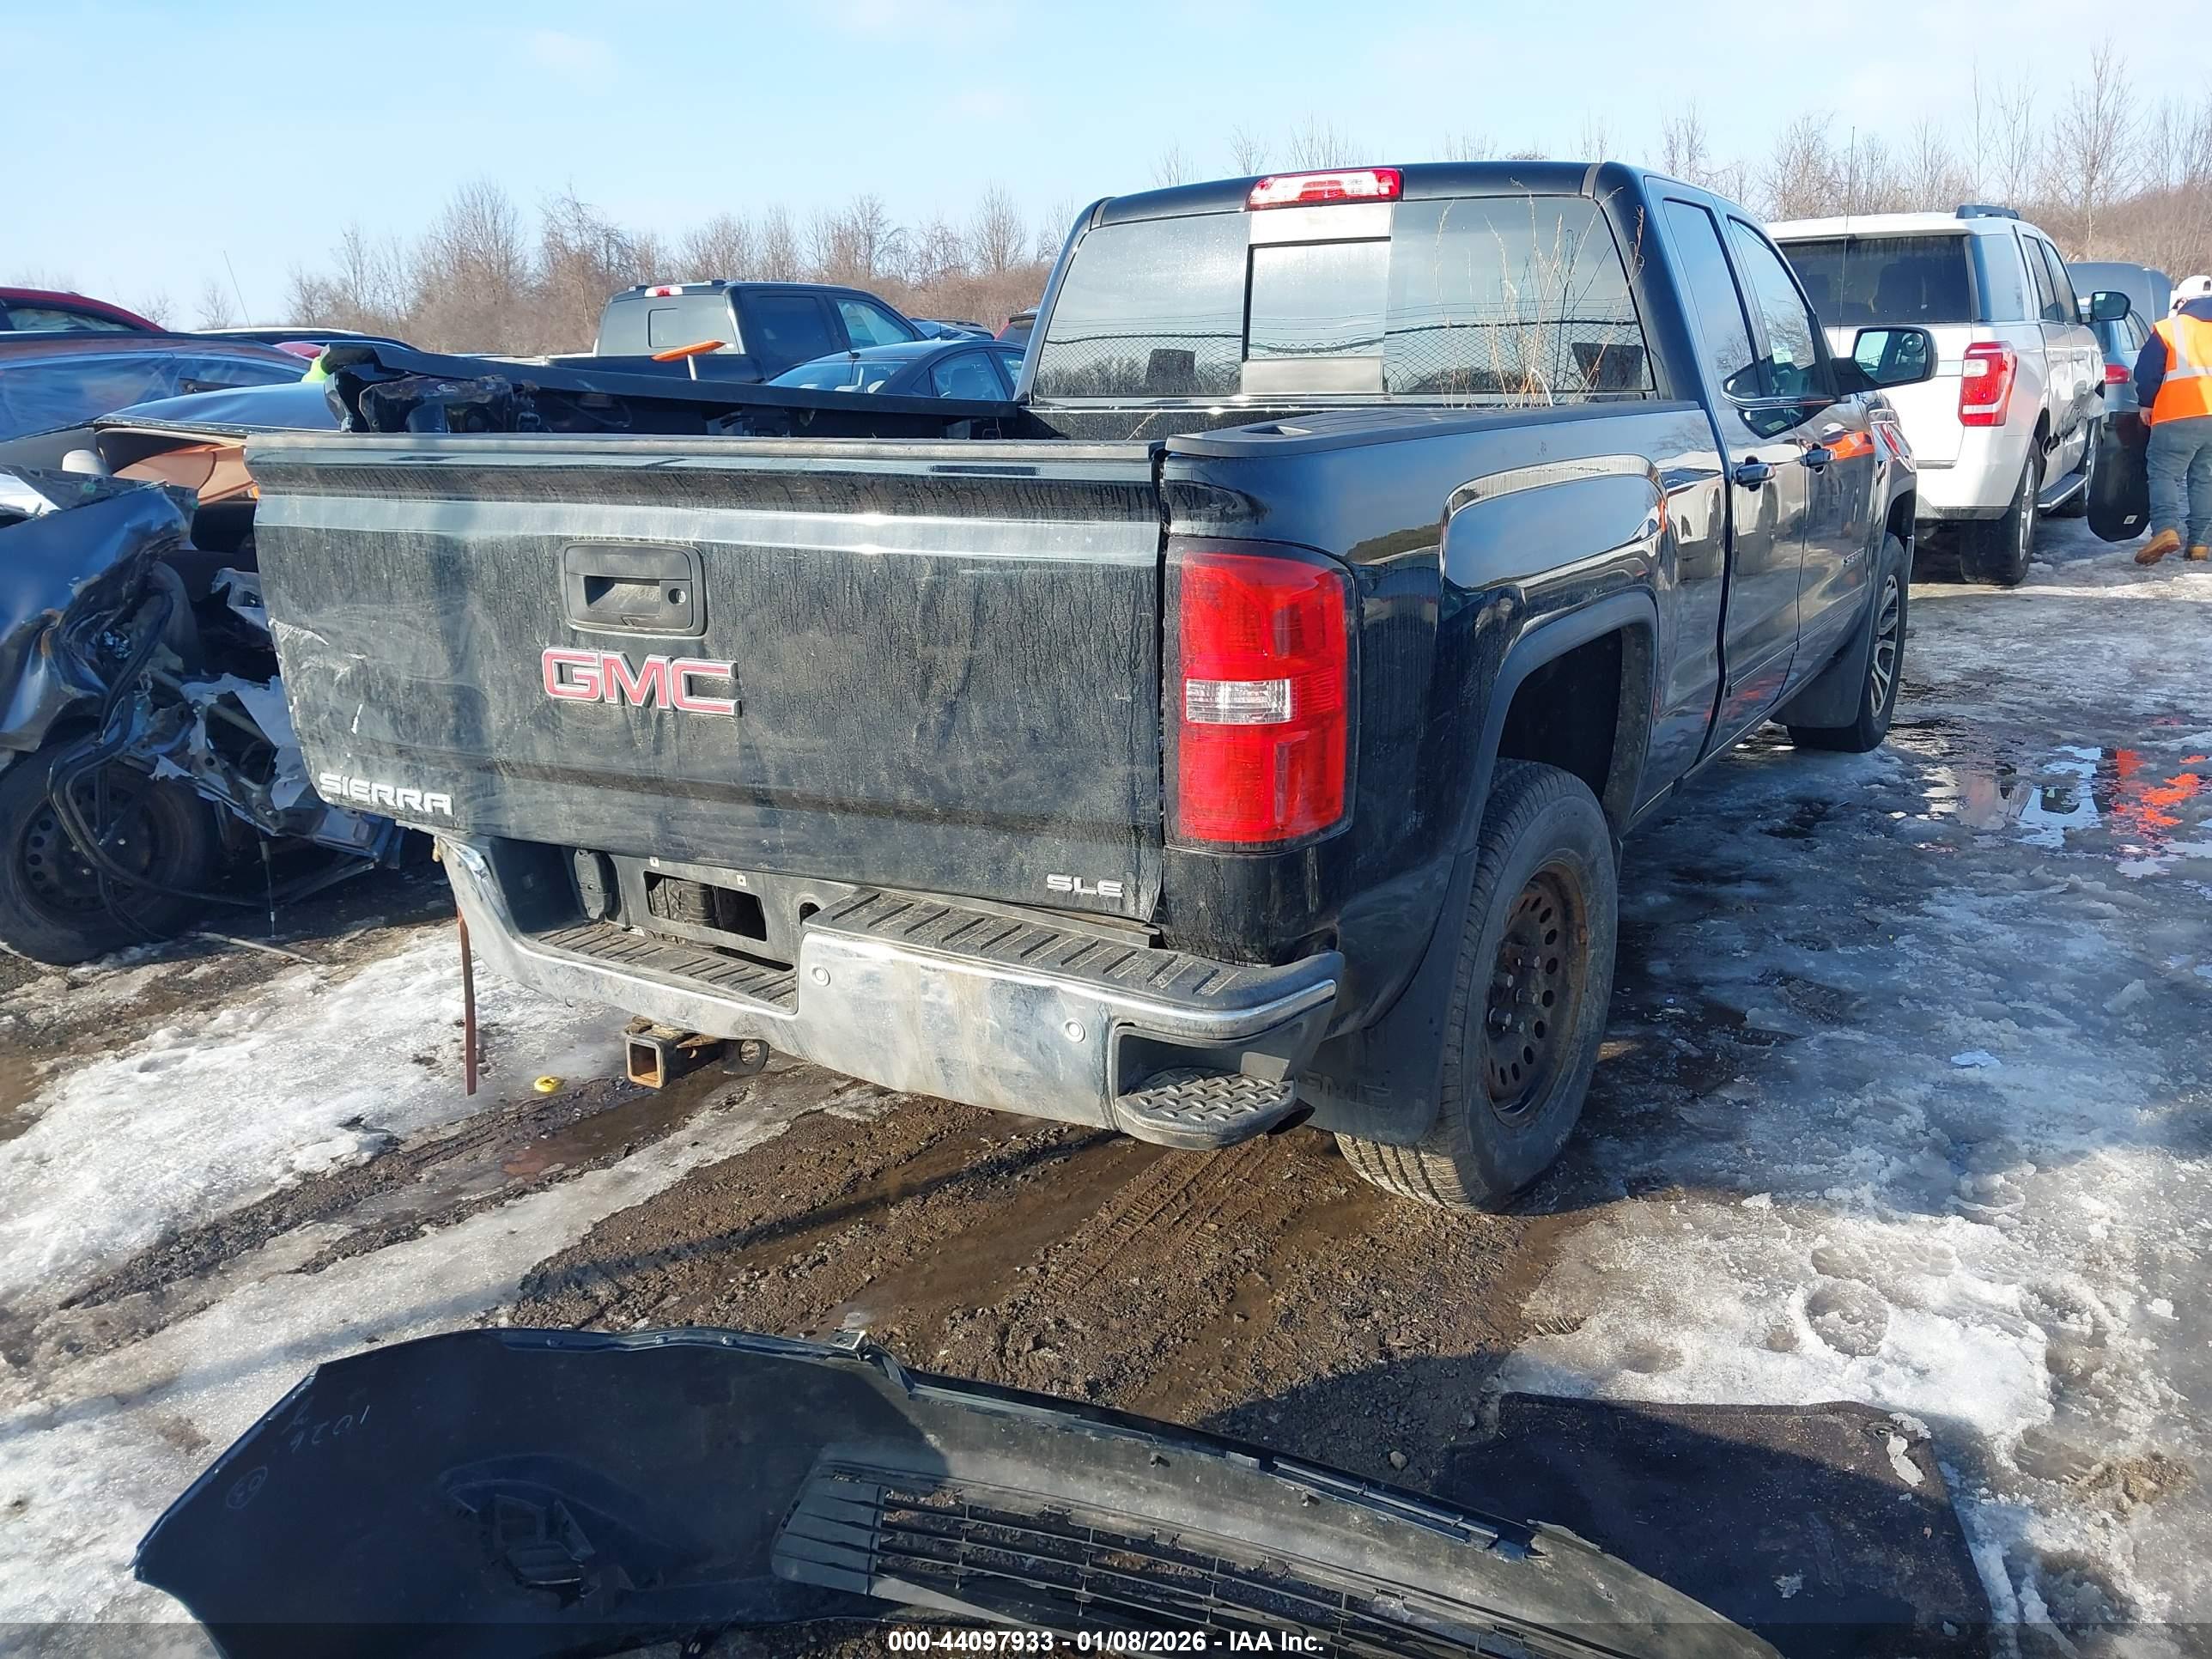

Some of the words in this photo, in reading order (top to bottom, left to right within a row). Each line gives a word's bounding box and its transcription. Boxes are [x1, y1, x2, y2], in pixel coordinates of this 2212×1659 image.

[542, 647, 742, 718] GMC
[319, 773, 454, 816] SIERRA
[1047, 873, 1124, 897] SLE
